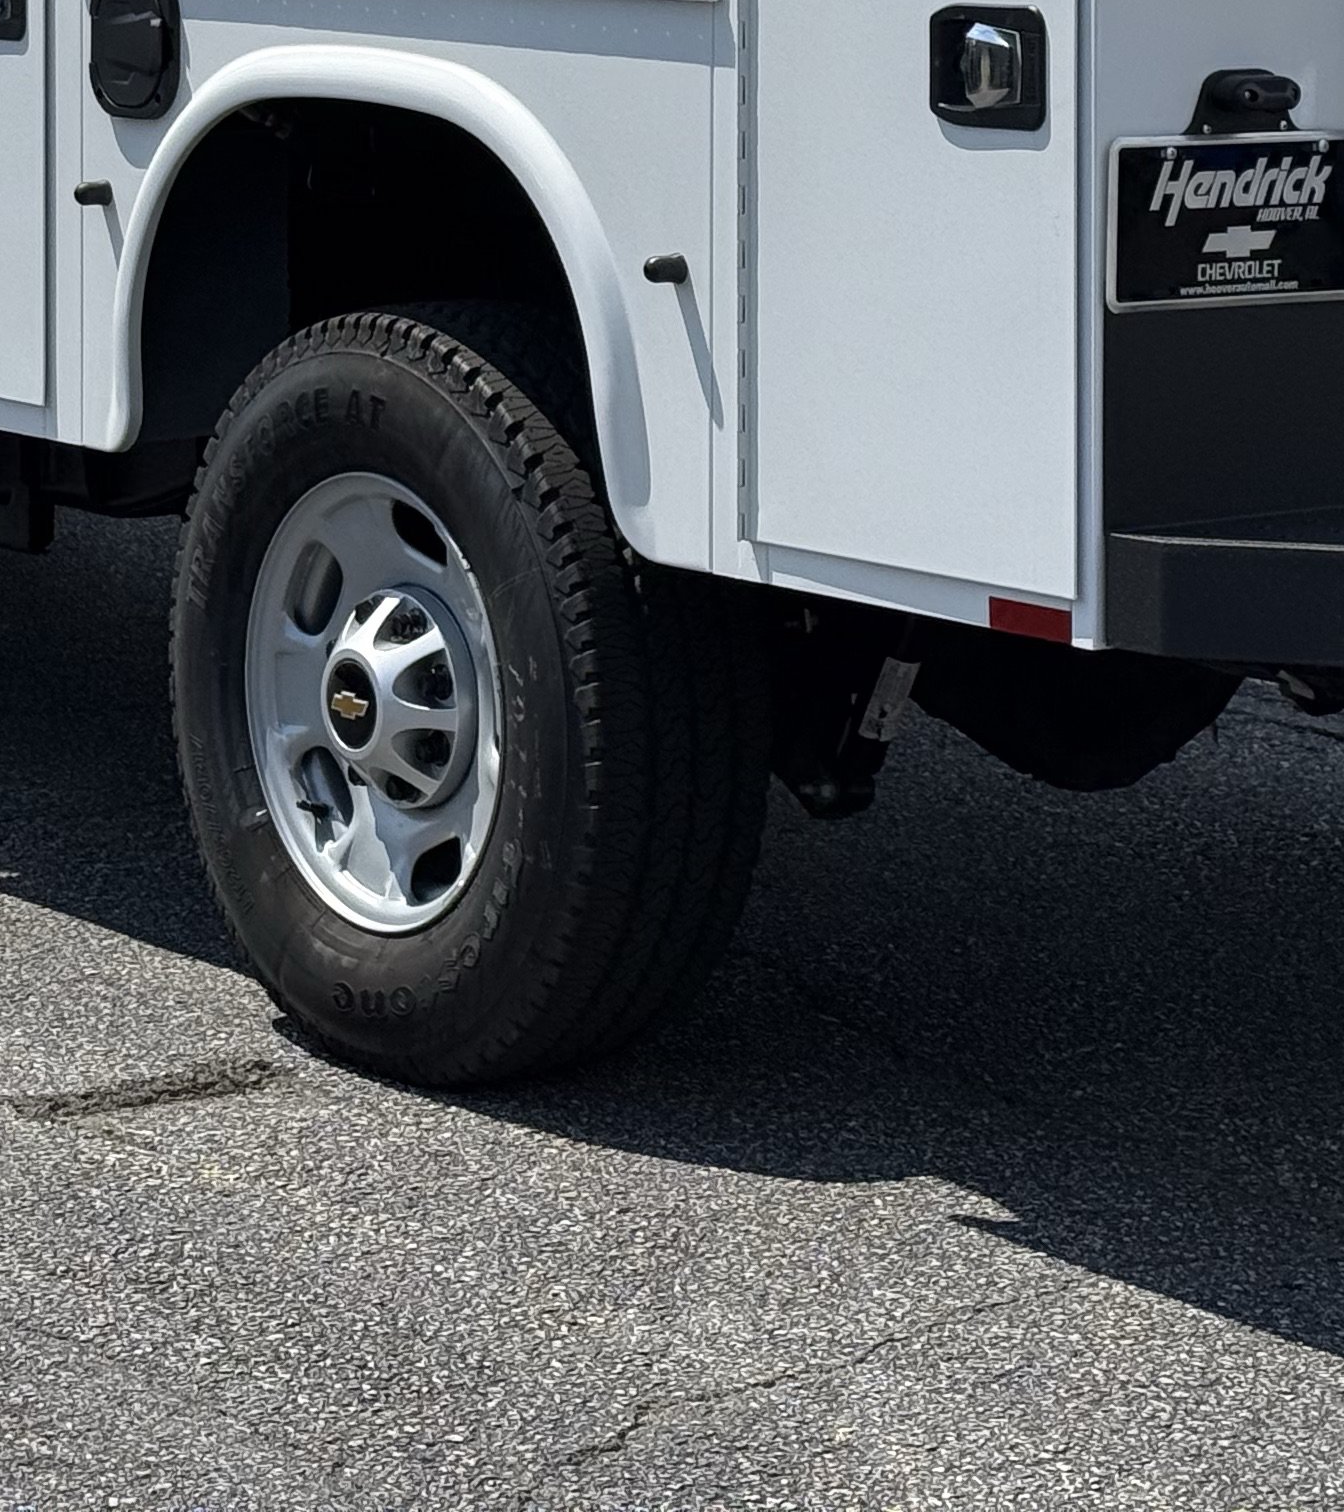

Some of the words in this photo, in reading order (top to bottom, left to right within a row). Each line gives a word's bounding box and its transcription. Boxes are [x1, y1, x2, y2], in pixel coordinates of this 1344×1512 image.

[1149, 155, 1333, 227] Hendrick
[1197, 259, 1282, 282] CHEVROLET
[344, 383, 388, 431] AT
